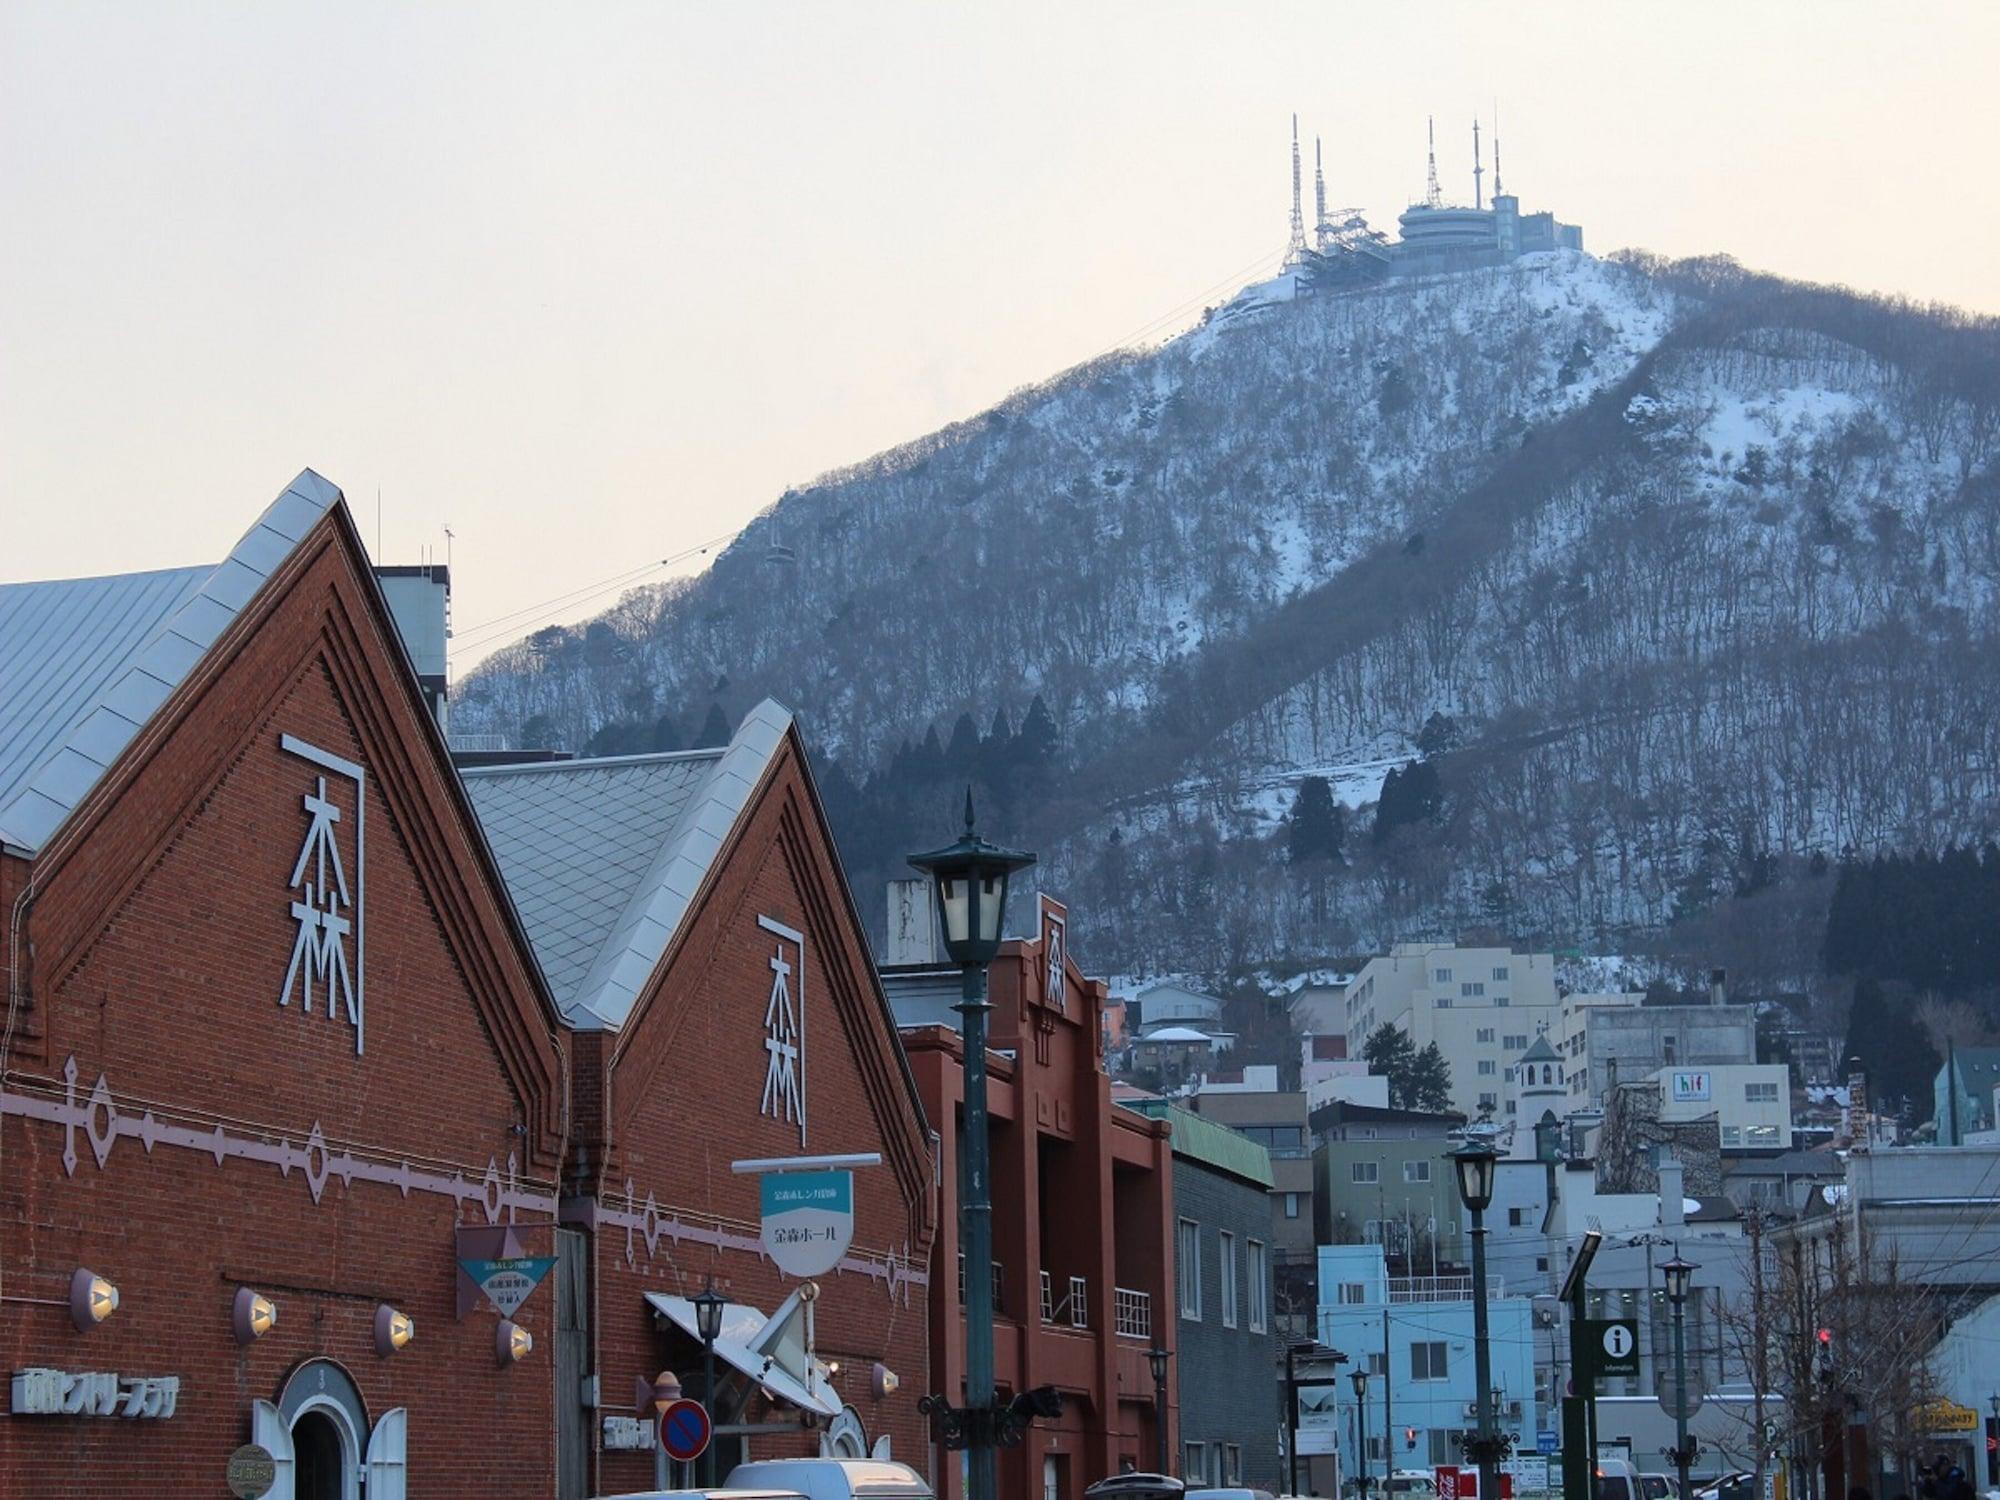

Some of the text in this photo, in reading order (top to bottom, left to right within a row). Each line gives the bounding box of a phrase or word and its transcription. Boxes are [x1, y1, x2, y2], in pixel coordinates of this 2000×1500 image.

[1680, 1075, 1702, 1092] hif
[774, 1226, 836, 1243] 金森ホール
[1766, 1426, 1776, 1441] P
